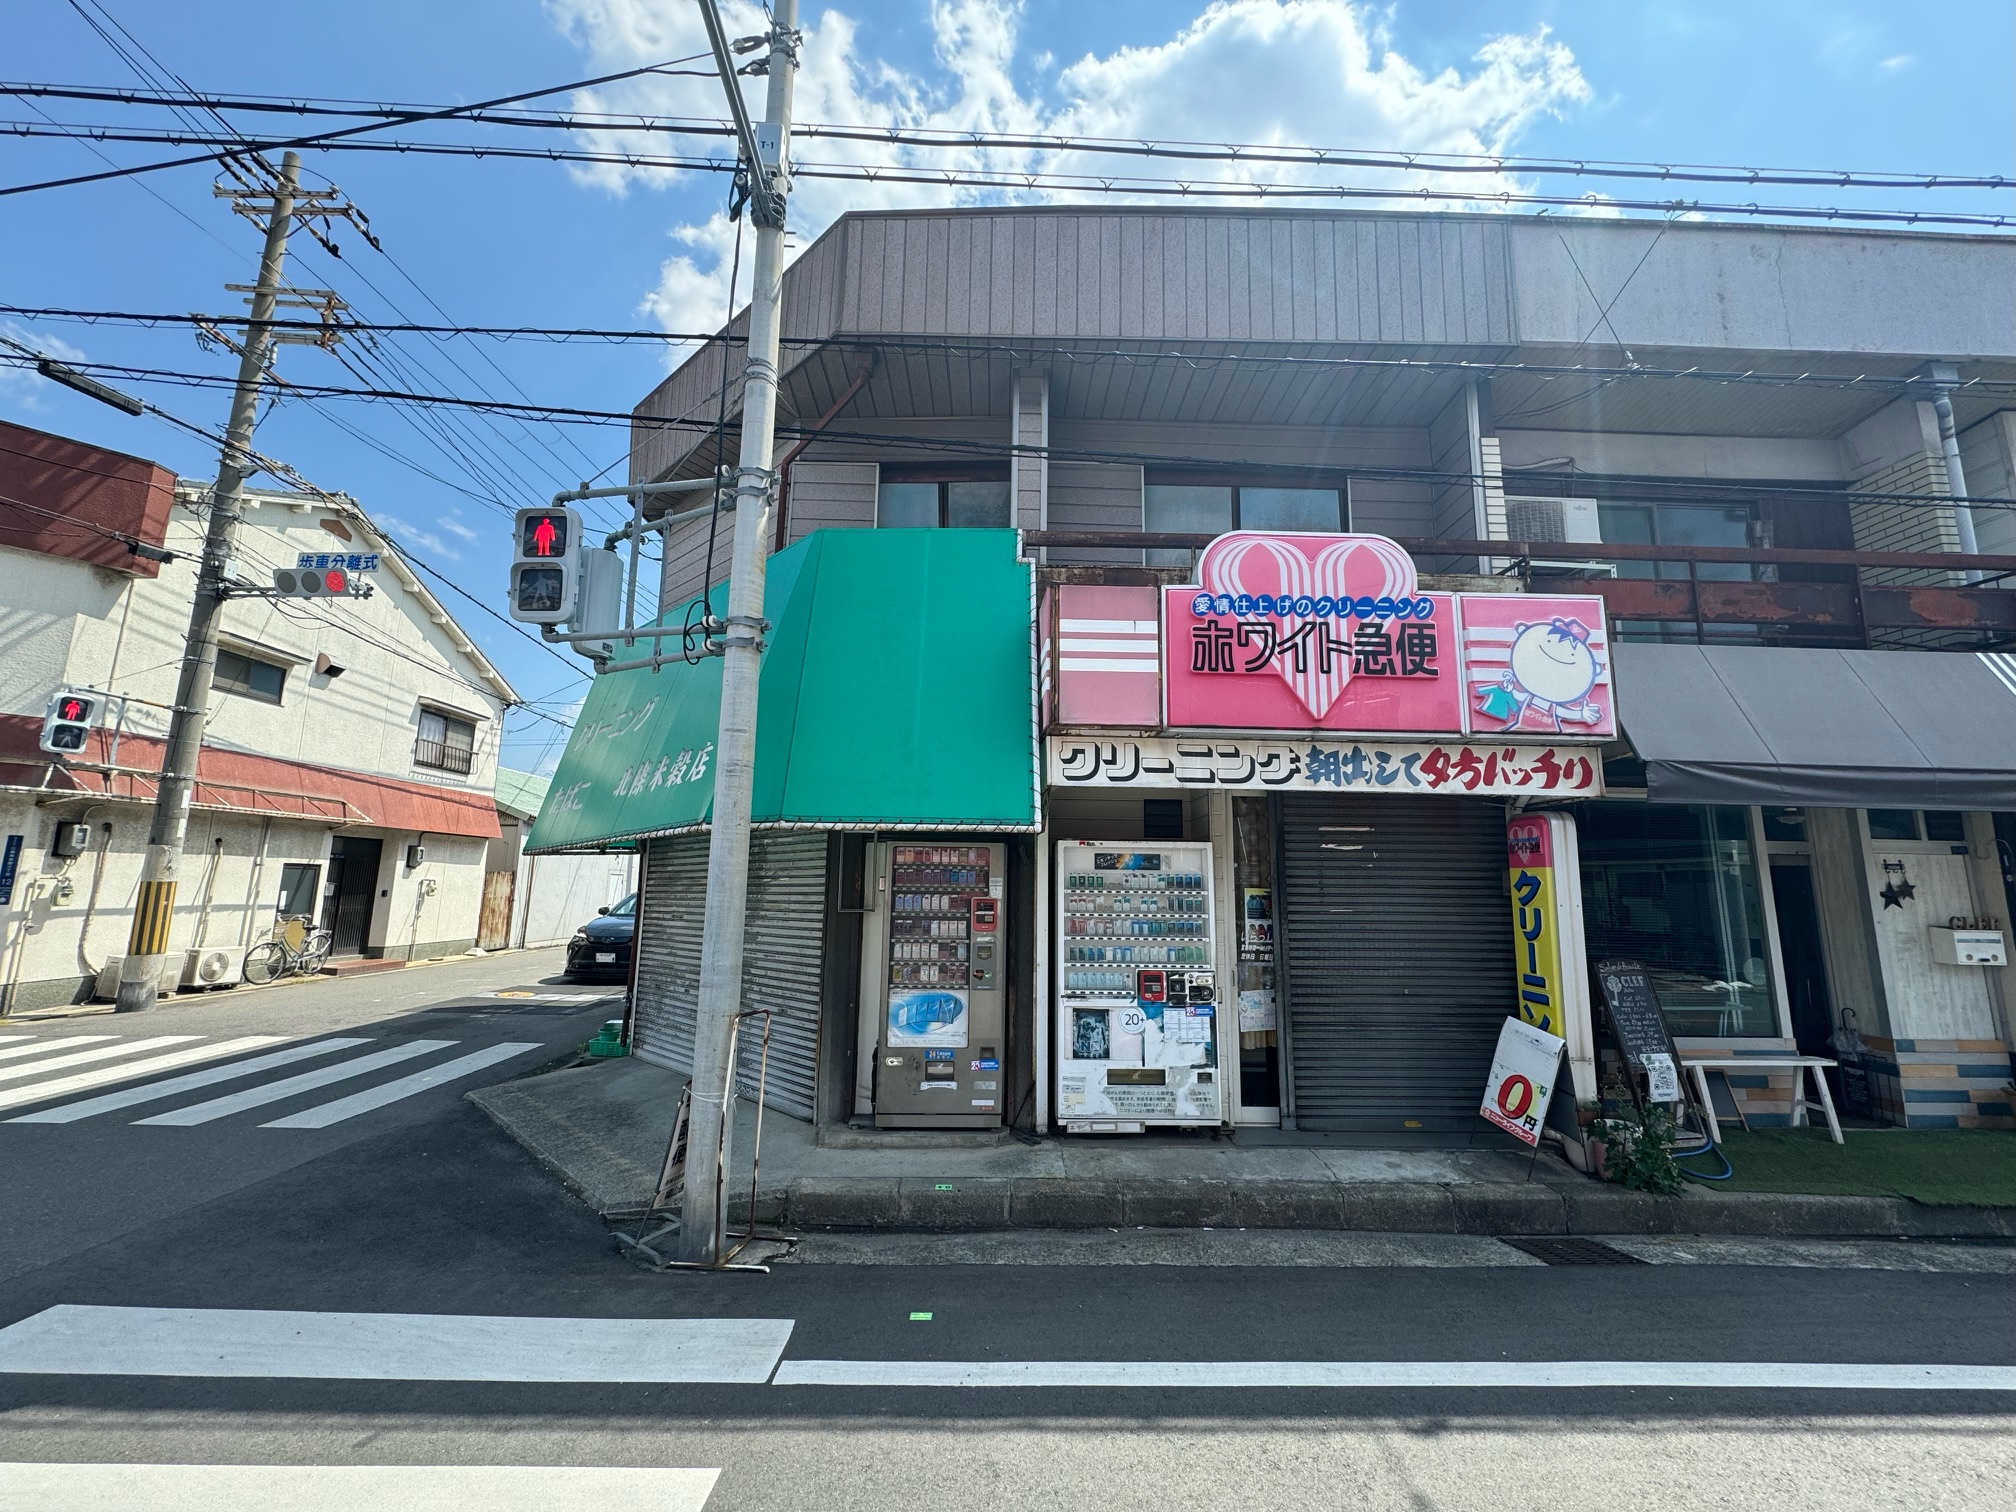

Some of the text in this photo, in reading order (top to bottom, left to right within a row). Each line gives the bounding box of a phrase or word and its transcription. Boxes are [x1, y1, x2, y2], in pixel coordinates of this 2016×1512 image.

[761, 141, 774, 149] T-1
[299, 554, 378, 570] 歩車分離式
[1194, 596, 1432, 619] 愛情仕上げのクリーニング
[1192, 619, 1439, 676] ホワイト急便
[573, 693, 660, 752] クリーニング
[1059, 741, 1594, 791] クリーニング 朝出して夕方バッチリ
[548, 779, 592, 815] たばこ
[1513, 869, 1550, 1033] クリーニン
[1125, 1013, 1145, 1026] 20+
